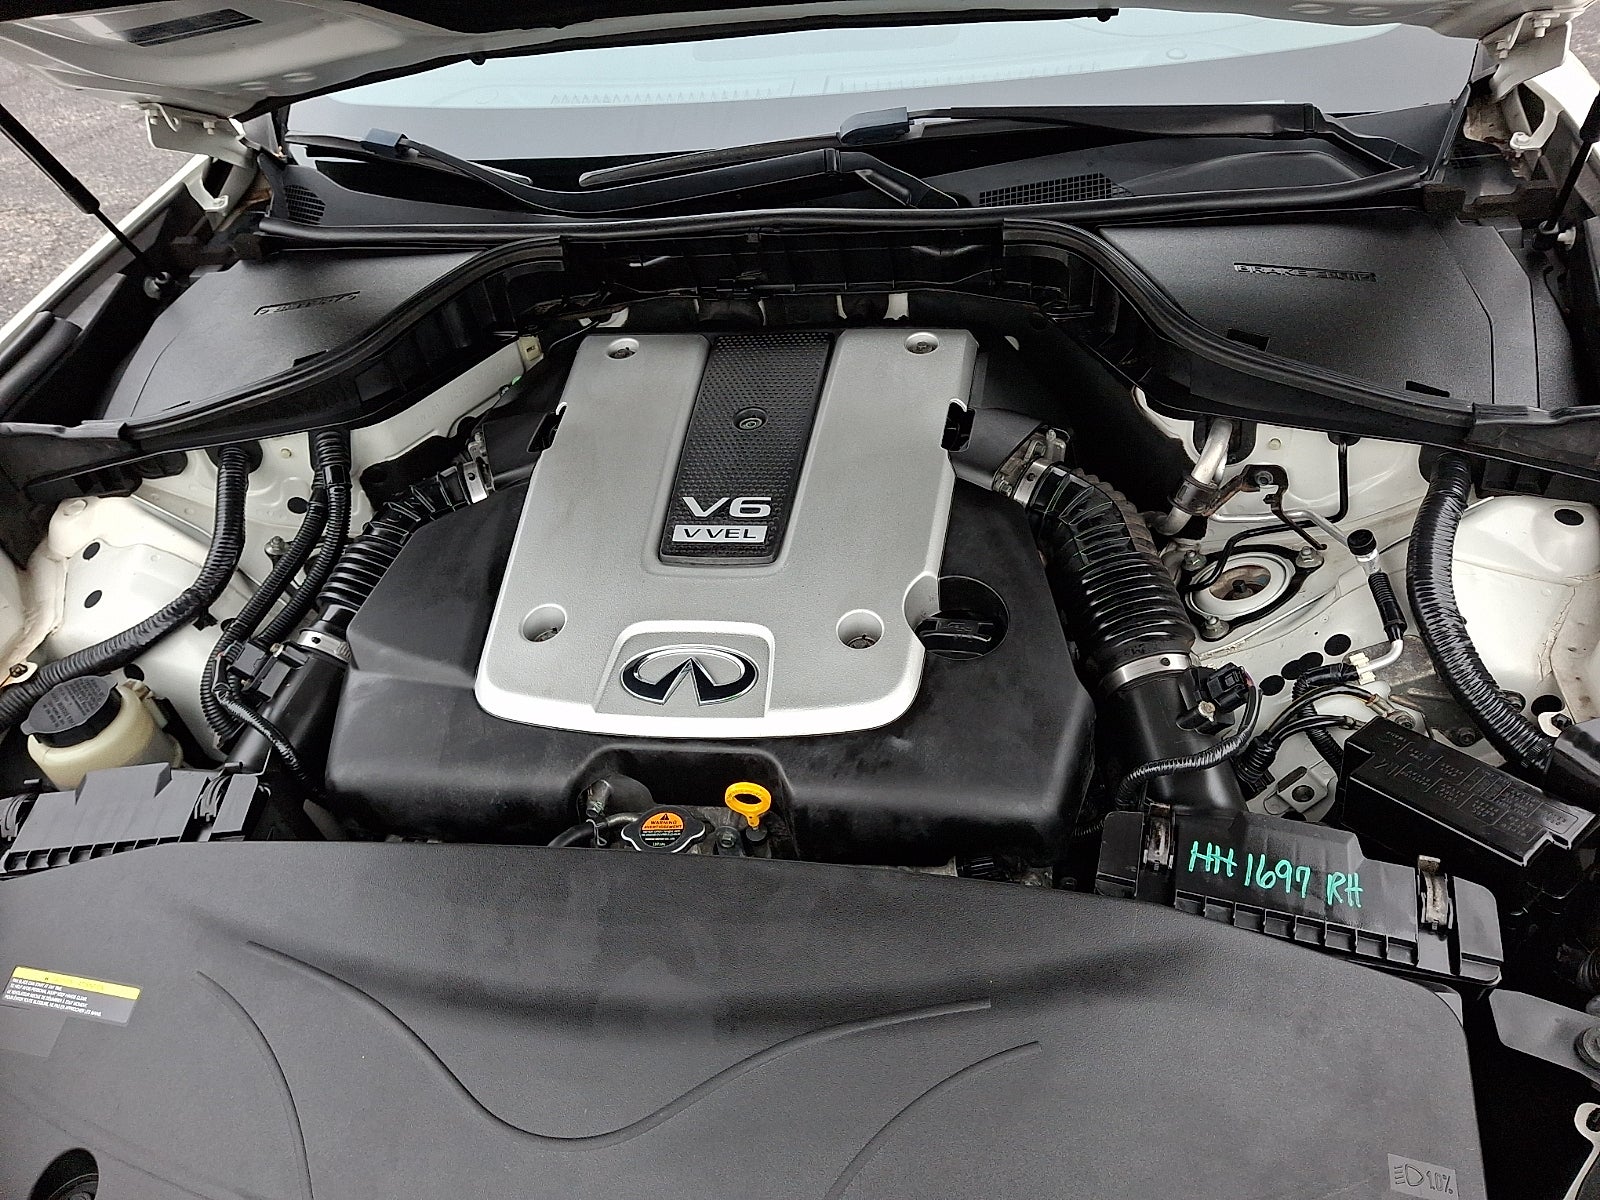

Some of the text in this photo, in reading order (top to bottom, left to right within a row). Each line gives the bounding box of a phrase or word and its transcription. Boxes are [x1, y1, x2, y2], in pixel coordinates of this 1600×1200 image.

[682, 496, 772, 518] V6
[1244, 853, 1311, 899] 1697
[1326, 871, 1364, 908] RH
